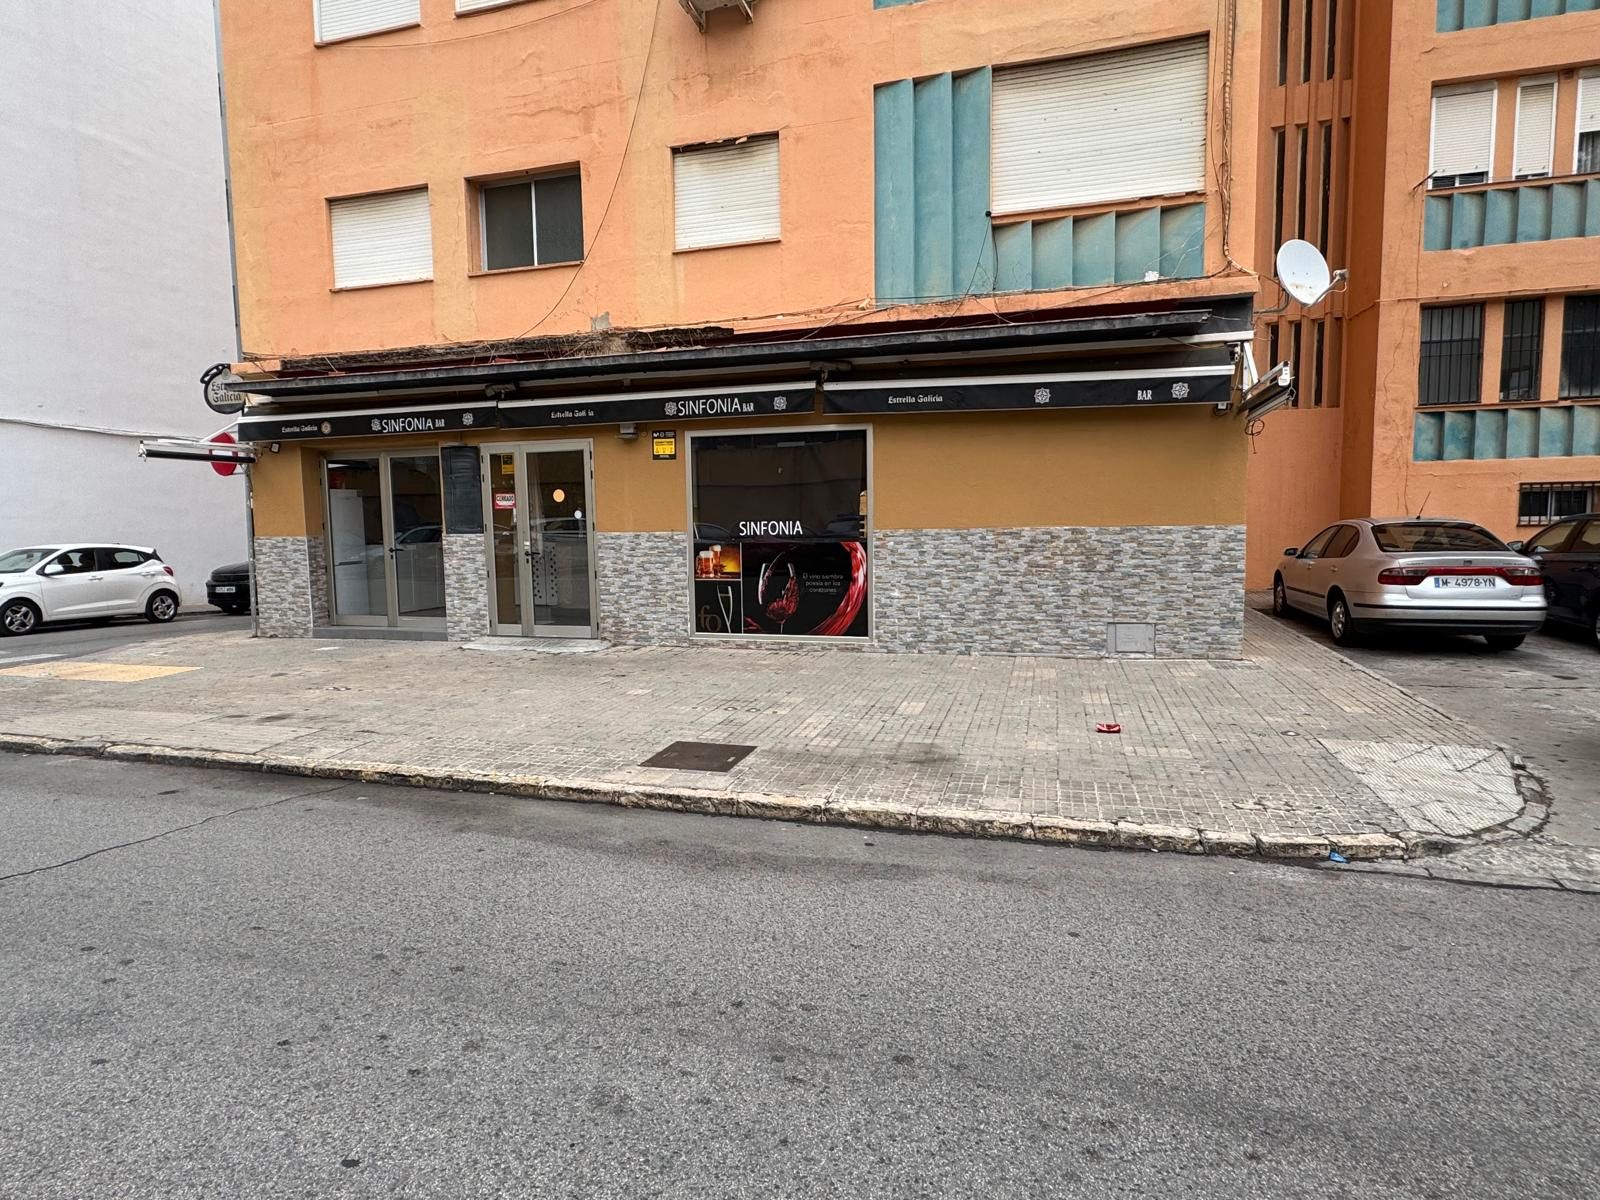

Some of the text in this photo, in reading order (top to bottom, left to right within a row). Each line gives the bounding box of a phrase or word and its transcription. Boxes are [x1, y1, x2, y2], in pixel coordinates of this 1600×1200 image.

[212, 391, 241, 402] Galicia
[887, 394, 943, 404] Estrella Galicia
[1136, 389, 1153, 401] BAR
[678, 397, 754, 416] SINFONIA BAR
[382, 417, 446, 433] SINFONIA BAR
[739, 520, 803, 536] SINFONIA
